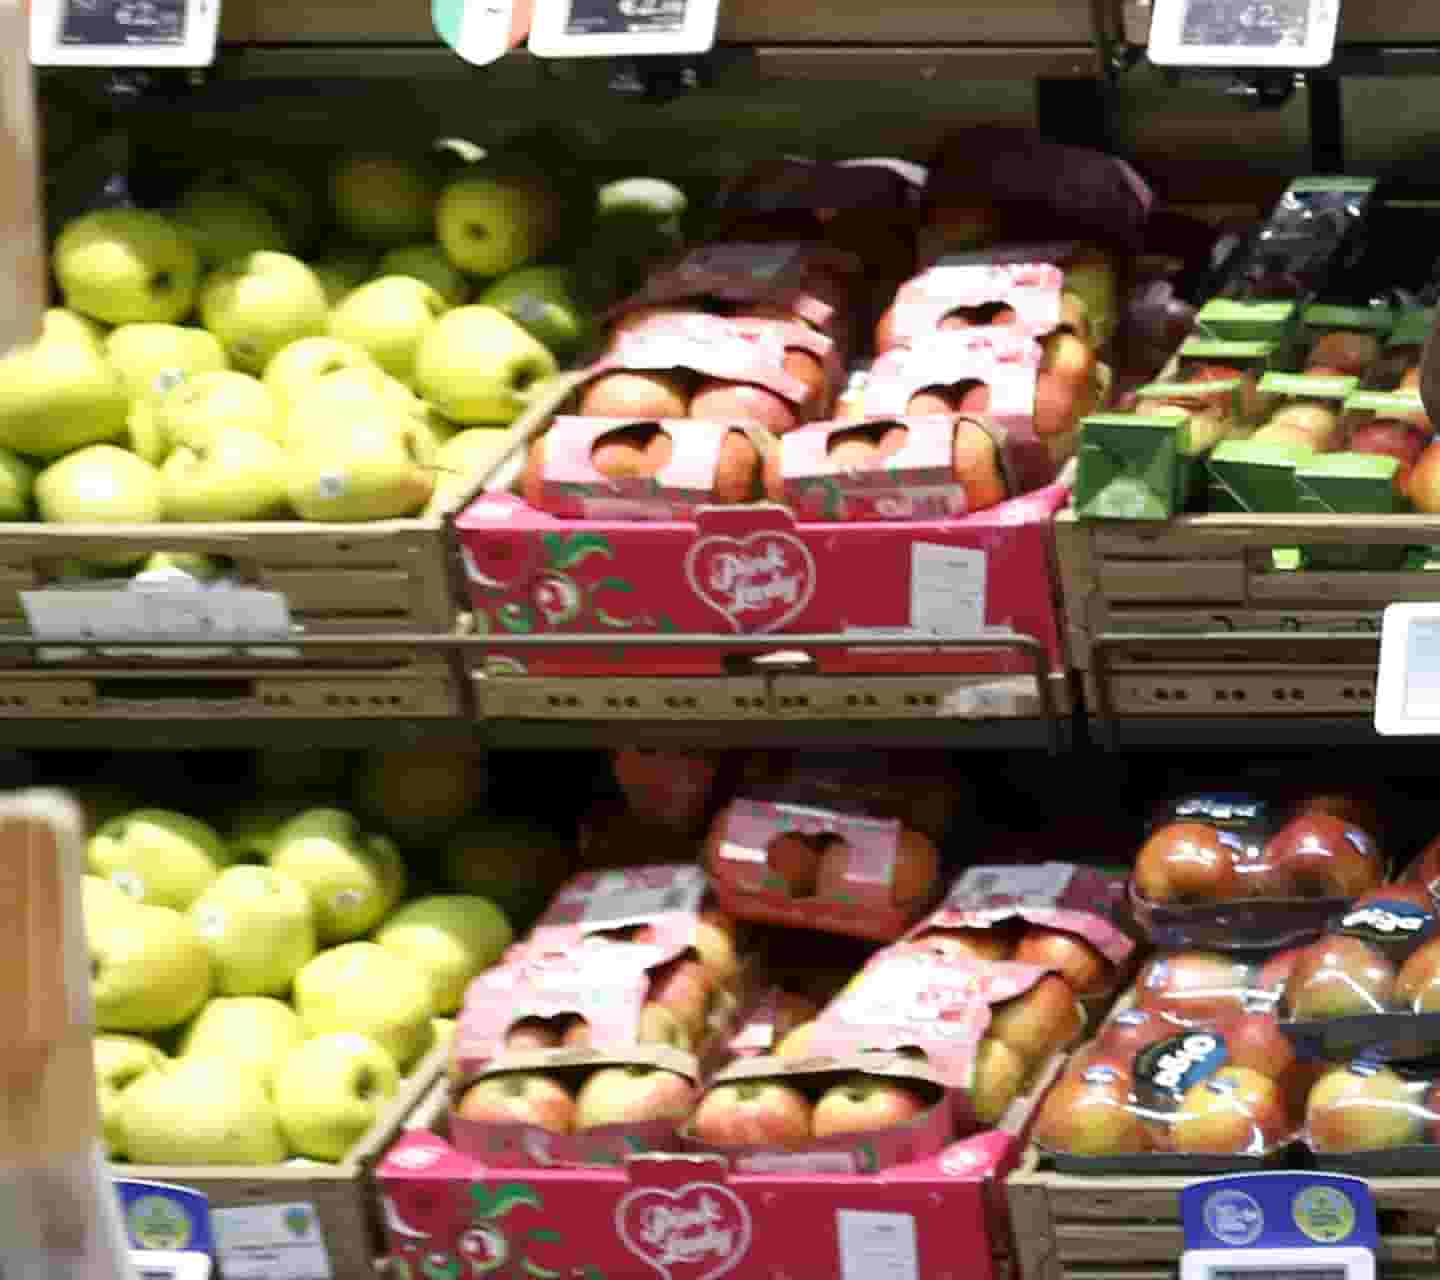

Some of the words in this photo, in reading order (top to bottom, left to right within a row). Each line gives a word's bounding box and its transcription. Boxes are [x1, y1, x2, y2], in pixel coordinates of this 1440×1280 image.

[711, 543, 790, 593] Pink
[734, 576, 803, 611] Lady
[640, 1195, 723, 1243] Pink
[656, 1231, 732, 1266] Lady
